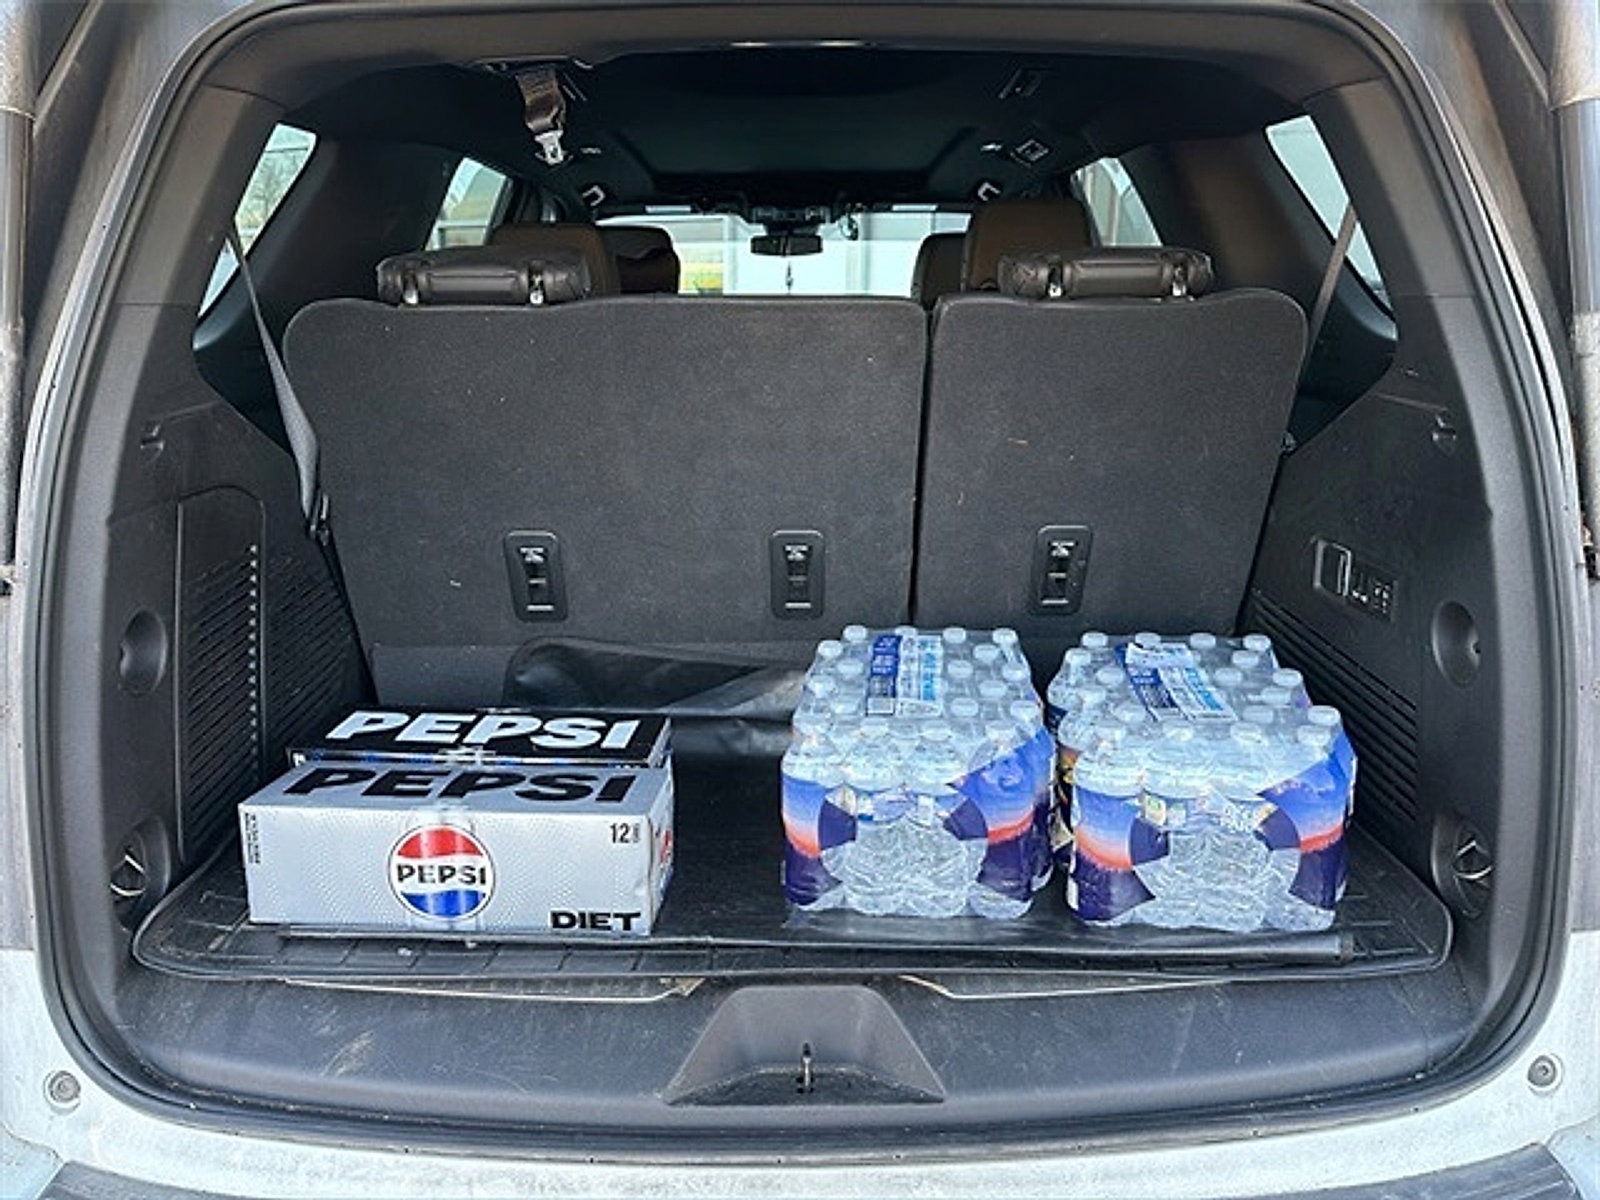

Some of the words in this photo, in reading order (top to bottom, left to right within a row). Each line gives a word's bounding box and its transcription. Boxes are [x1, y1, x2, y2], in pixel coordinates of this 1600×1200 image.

[326, 711, 640, 749] PEPSI
[285, 768, 636, 803] PEPSI
[610, 823, 629, 843] 12
[397, 865, 487, 885] PEPSI
[551, 911, 642, 932] DIET
